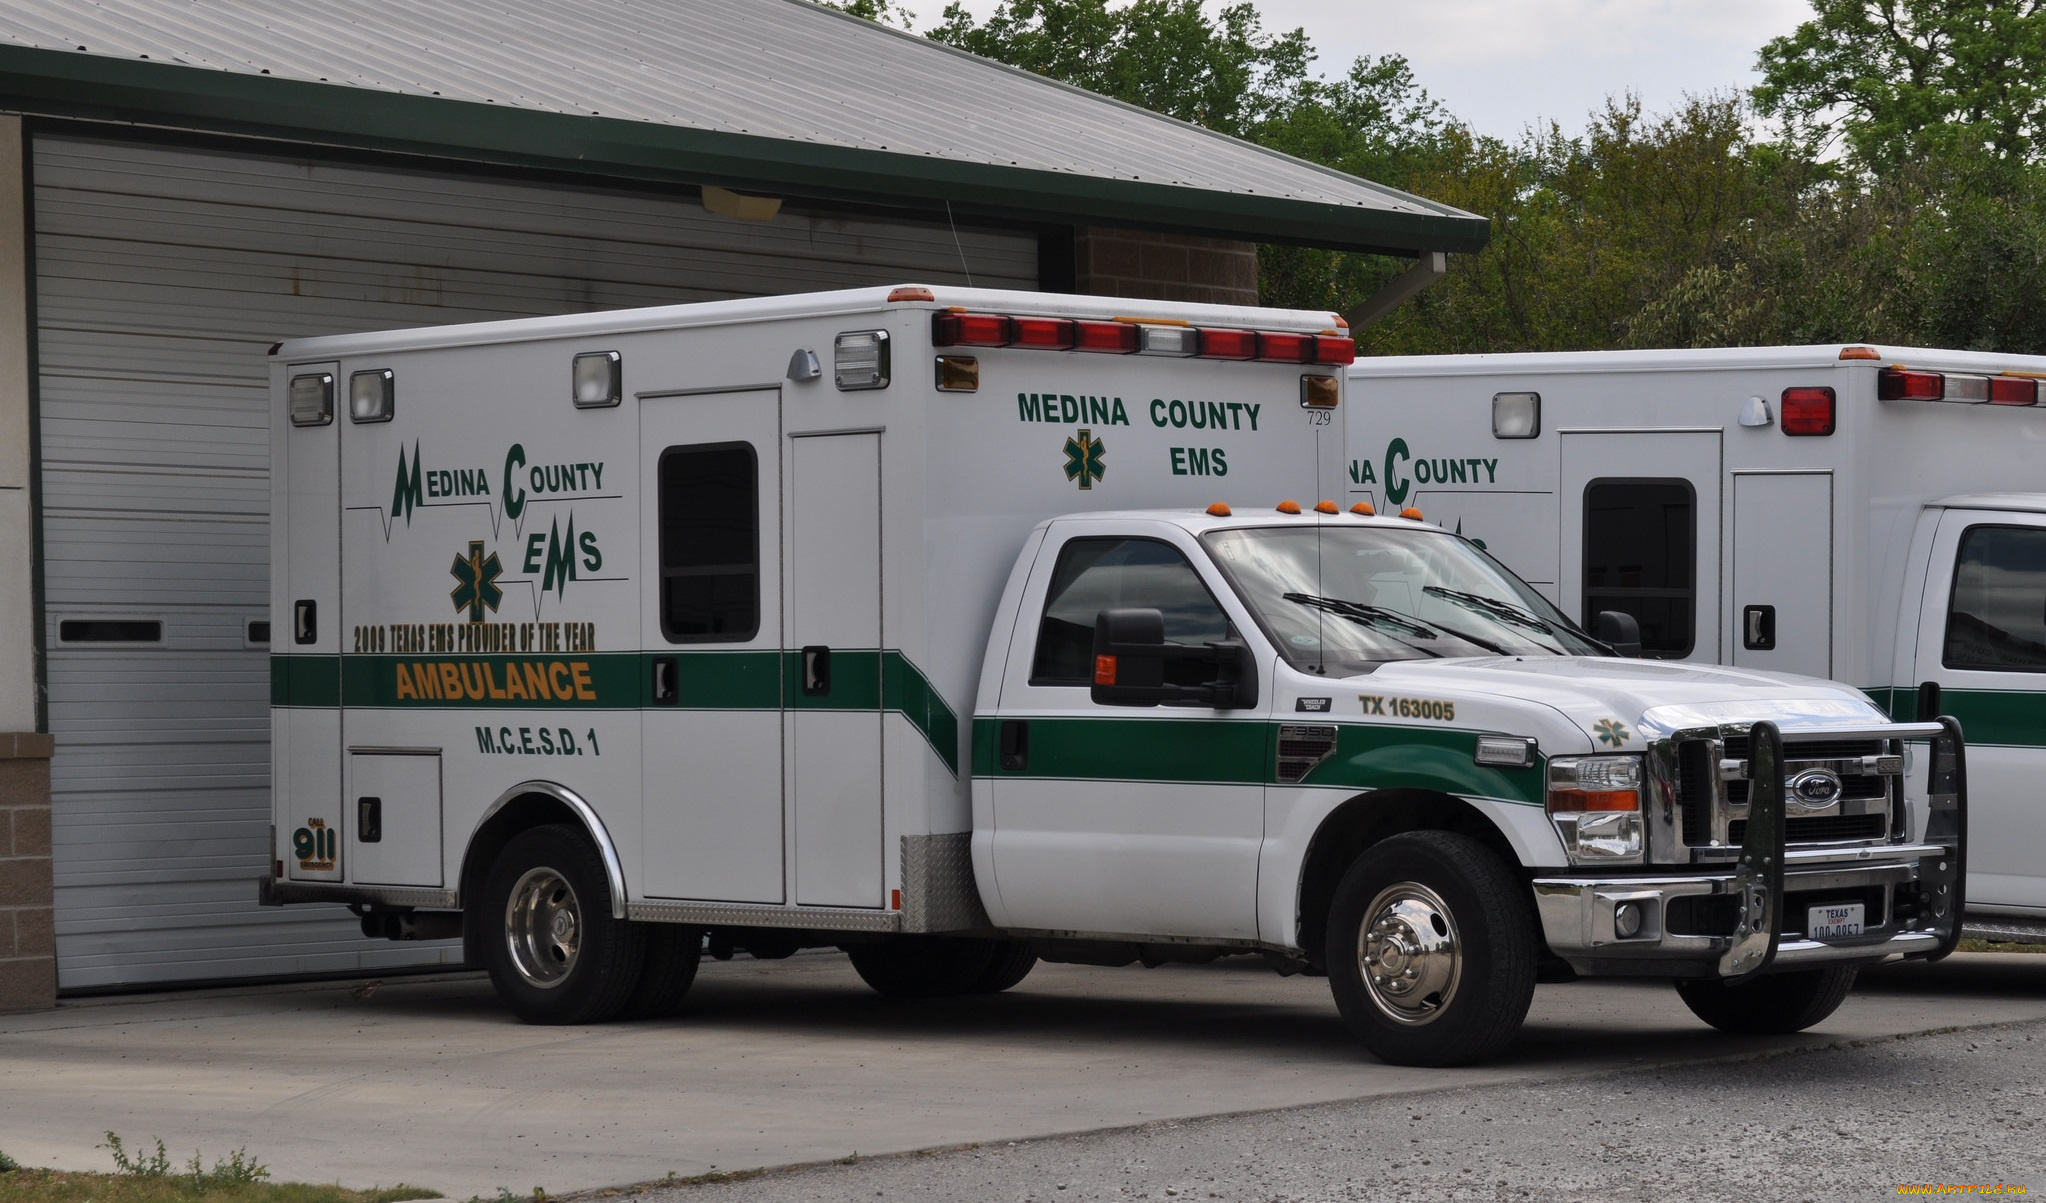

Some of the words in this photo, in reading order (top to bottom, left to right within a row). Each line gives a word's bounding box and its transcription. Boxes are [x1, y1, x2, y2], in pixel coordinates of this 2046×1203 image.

[1017, 393, 1130, 426] MEDINA
[1150, 398, 1261, 431] COUNTY
[1307, 410, 1331, 426] 729
[1170, 447, 1228, 477] EMS
[1384, 437, 1498, 505] COUNTY
[391, 437, 490, 529] MEDINA
[503, 443, 604, 520] COUNTY
[522, 507, 602, 604] EMS
[354, 625, 386, 653] 2009
[390, 623, 425, 653] TEXAS
[428, 623, 454, 652] EMS
[458, 622, 516, 652] PROVIDER
[520, 622, 535, 652] OF
[538, 622, 560, 652] THE
[564, 622, 596, 652] YEAR
[396, 661, 597, 700] AMBULANCE
[1358, 694, 1386, 716] TX
[1389, 697, 1455, 721] 163005
[475, 726, 583, 756] M.C.E.S.D.
[587, 728, 600, 756] 1
[1808, 779, 1832, 795] Ford
[293, 827, 336, 862] 911
[1826, 908, 1848, 919] TEXAS
